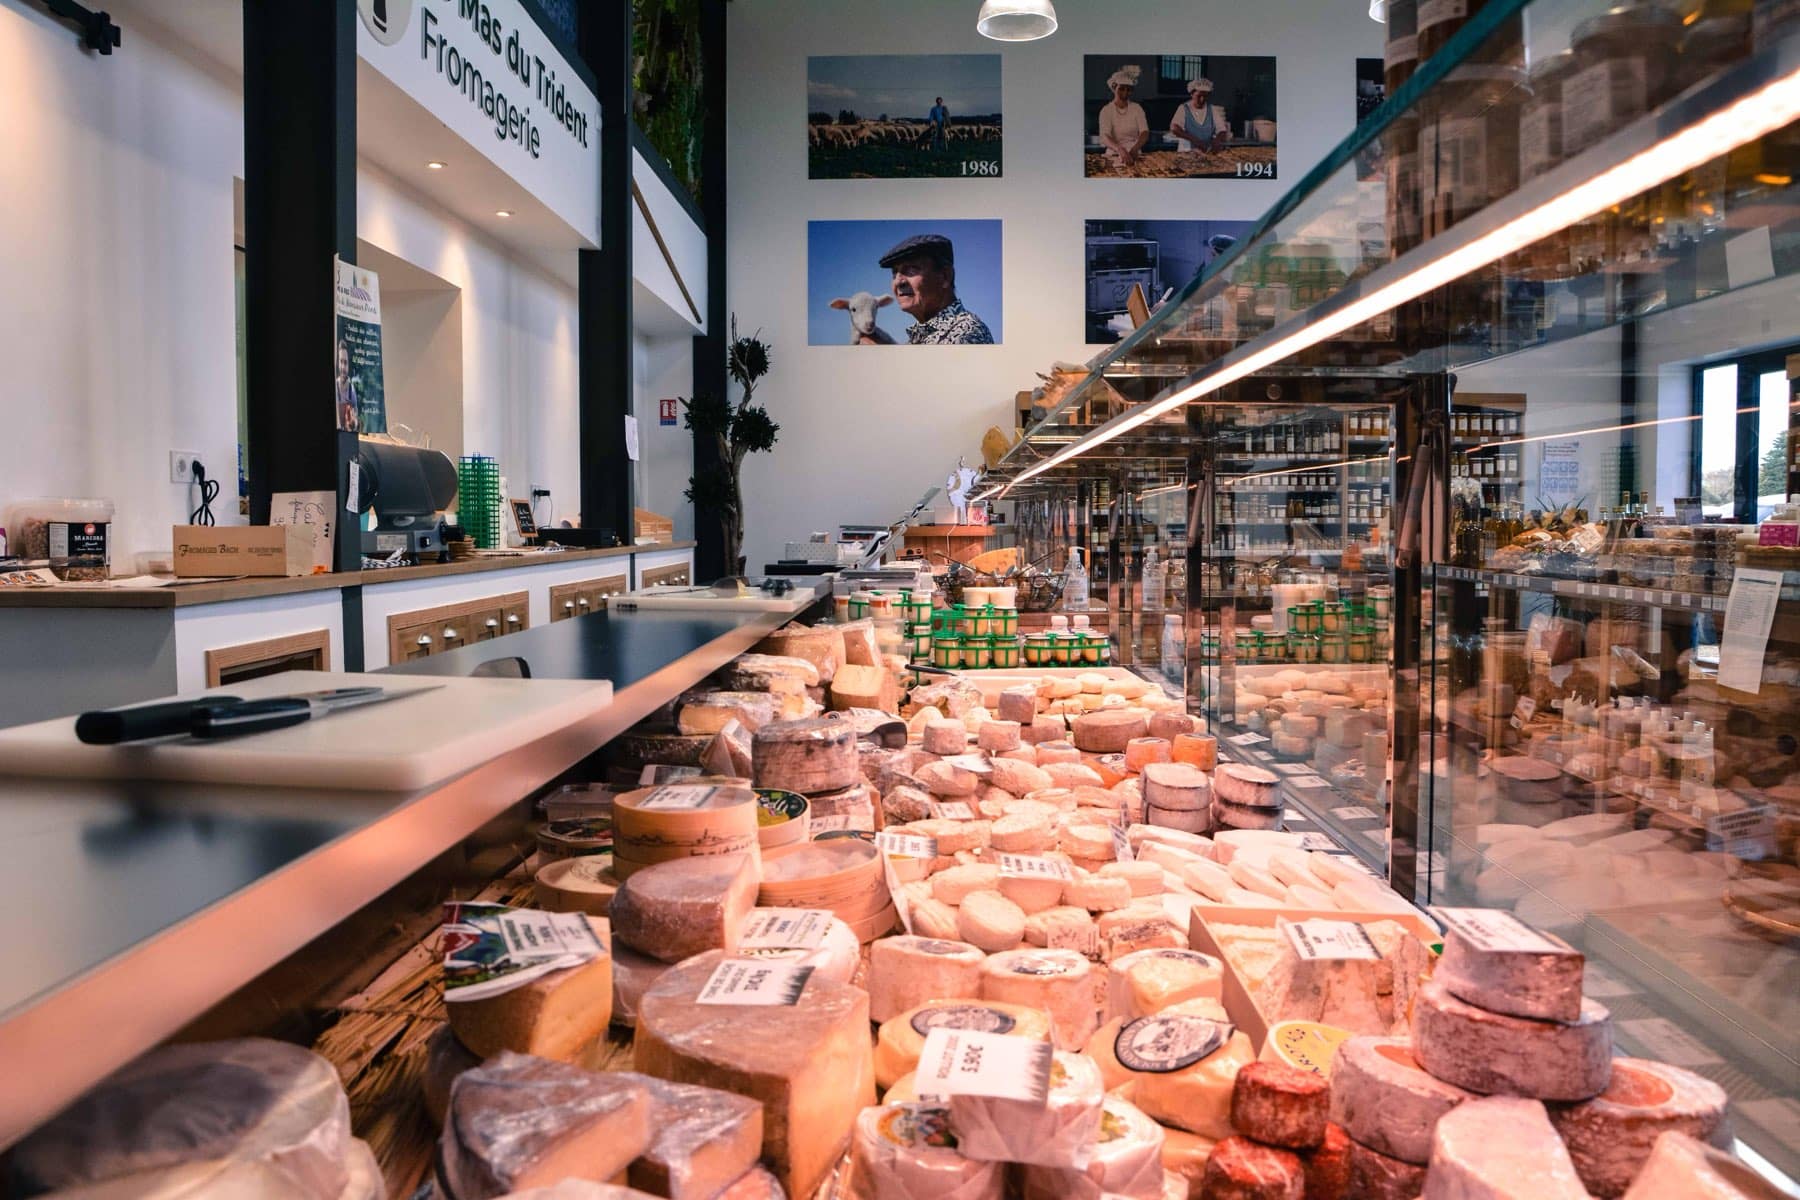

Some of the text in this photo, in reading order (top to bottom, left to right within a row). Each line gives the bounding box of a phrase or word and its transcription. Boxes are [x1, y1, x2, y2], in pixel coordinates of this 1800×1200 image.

[421, 6, 540, 159] Fromagerie
[506, 29, 530, 88] du
[534, 55, 588, 148] Trident
[960, 160, 999, 175] 1986
[1235, 161, 1273, 177] 1994
